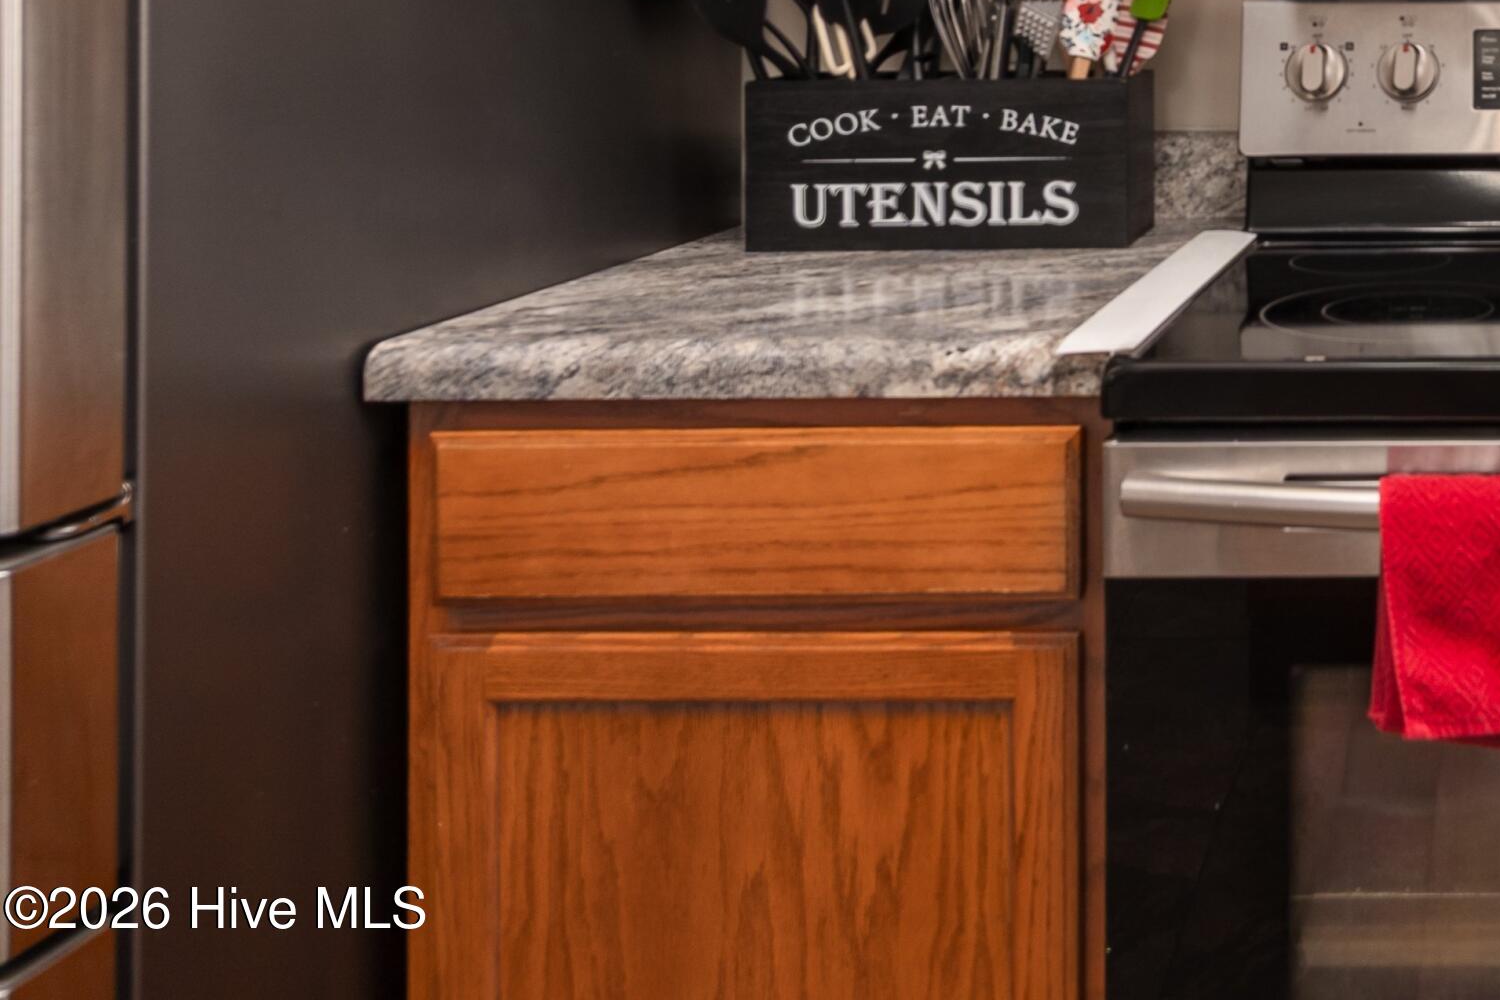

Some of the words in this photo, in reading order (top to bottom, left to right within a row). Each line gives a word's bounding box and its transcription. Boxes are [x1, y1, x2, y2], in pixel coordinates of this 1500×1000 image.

[787, 108, 882, 147] COOK
[910, 105, 972, 128] EAT
[999, 108, 1081, 145] BAKE
[789, 180, 1080, 229] UTENSILS
